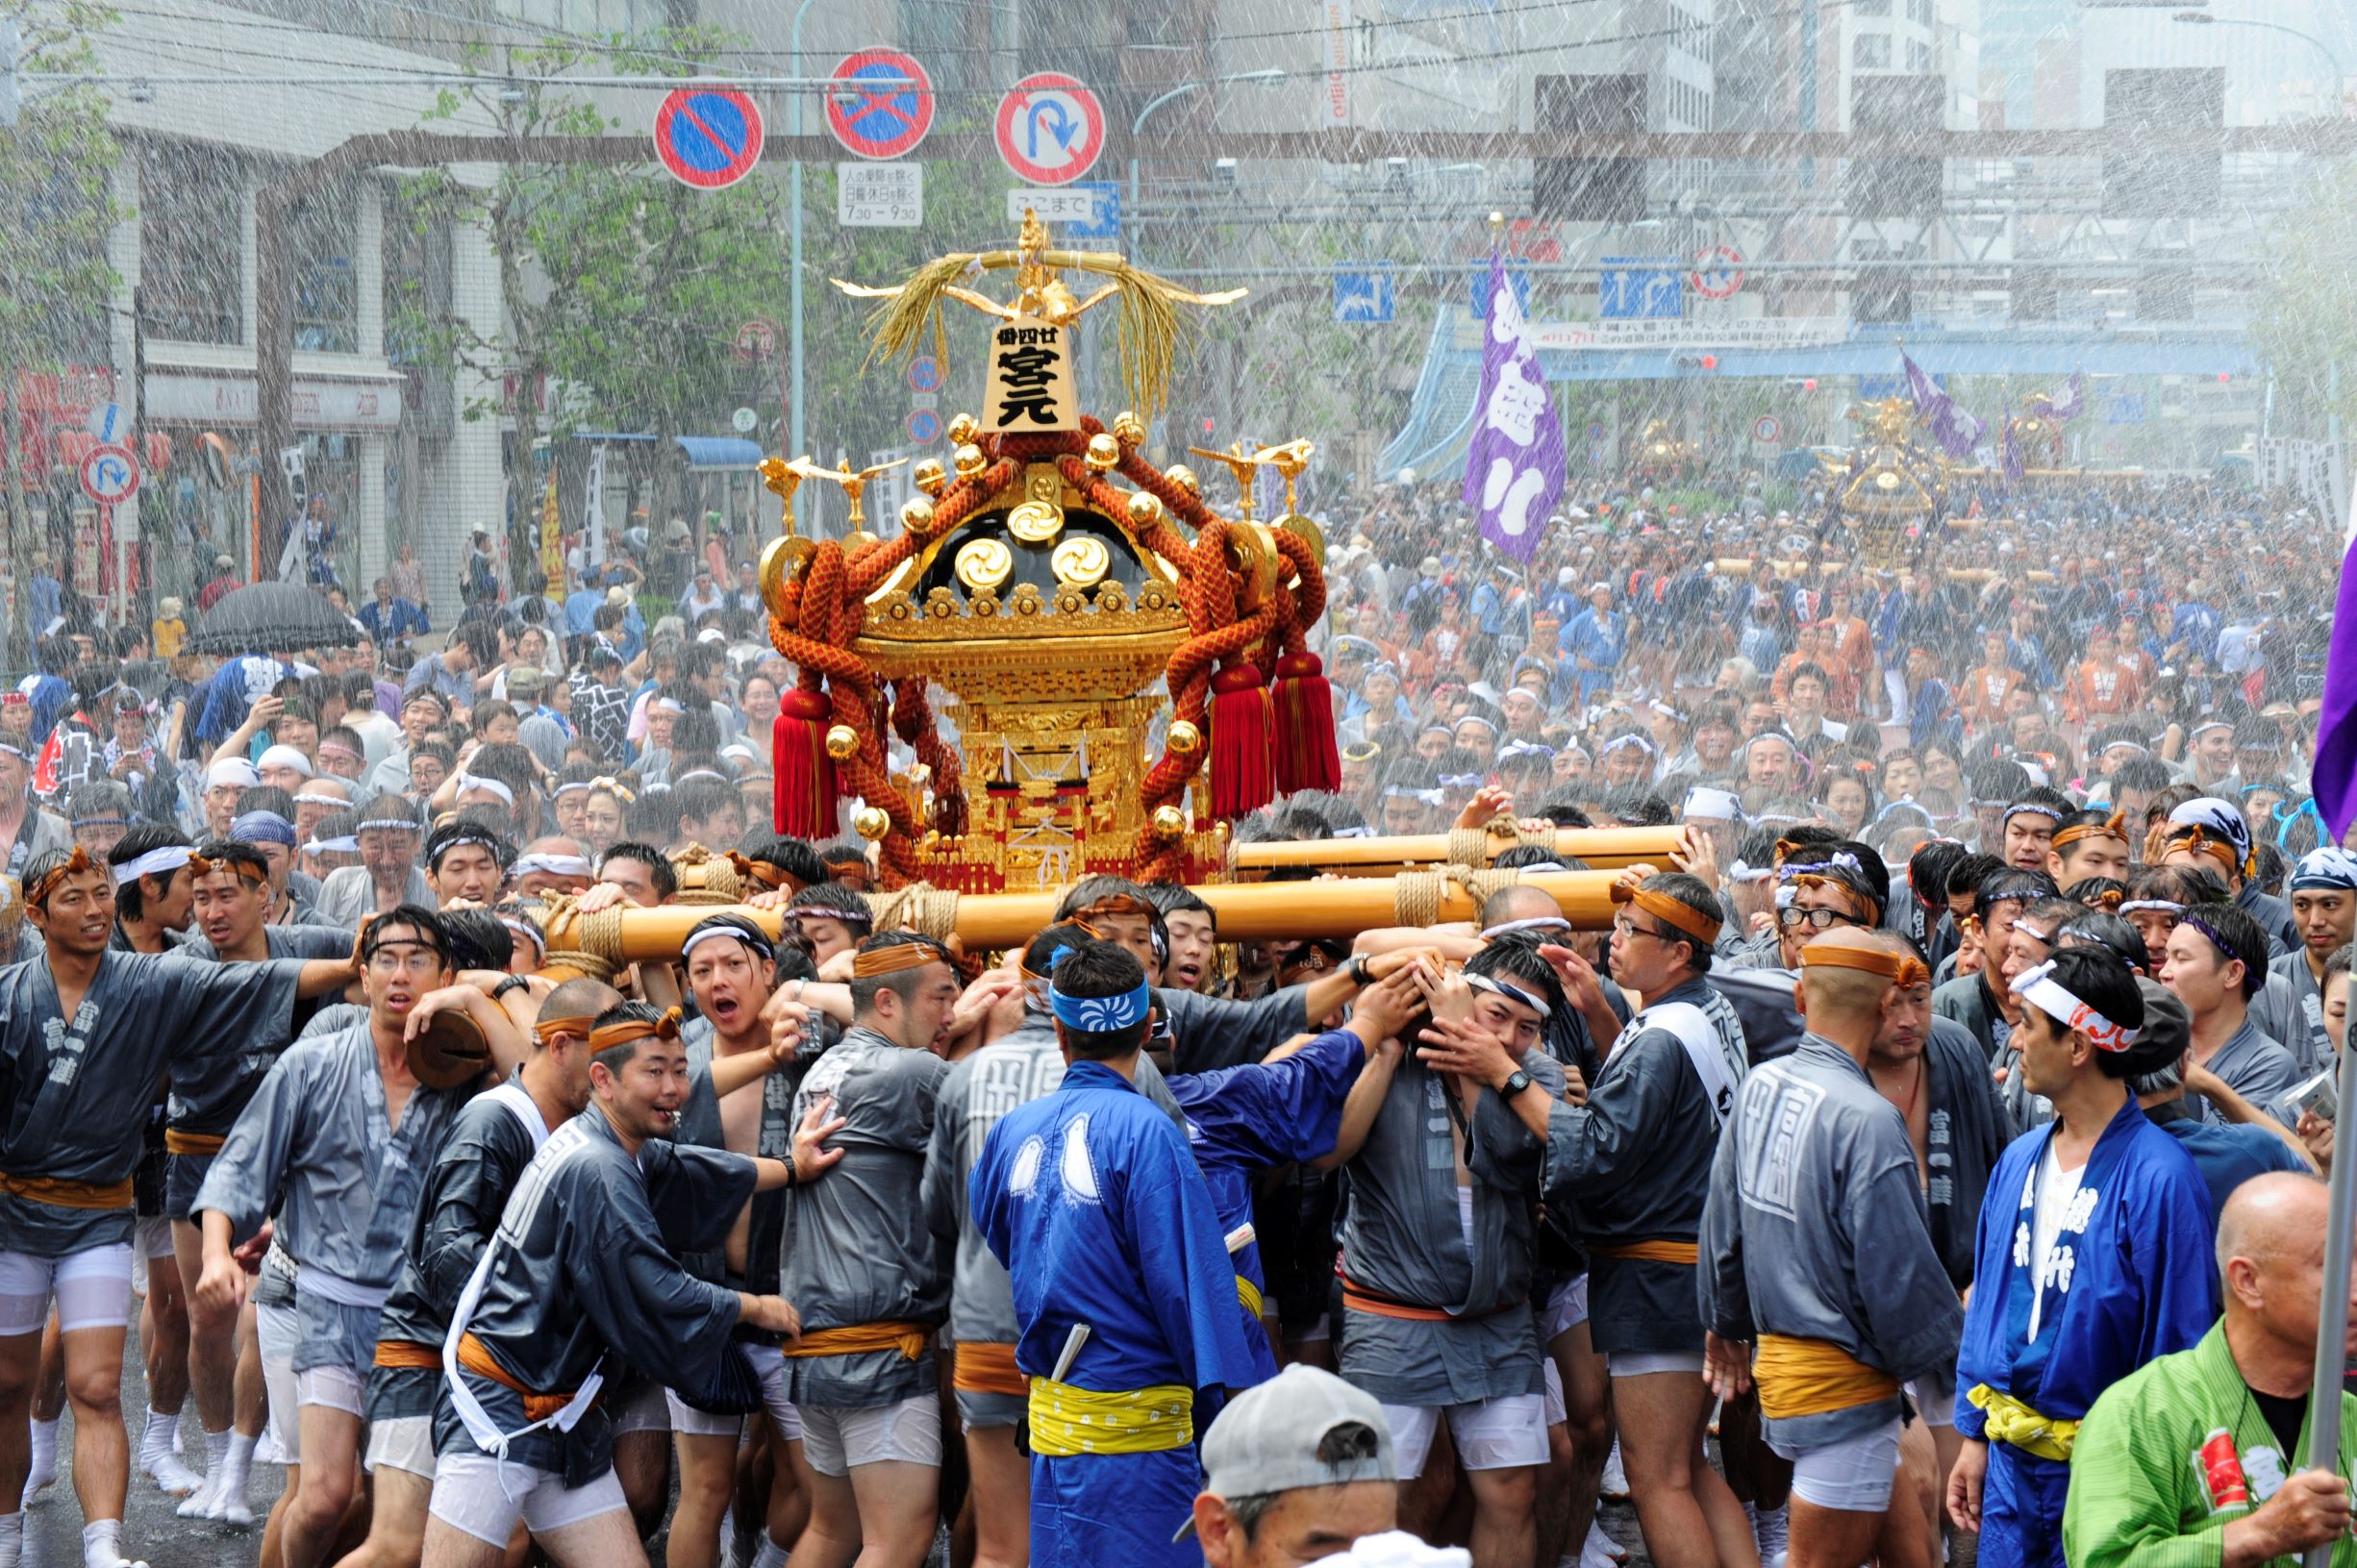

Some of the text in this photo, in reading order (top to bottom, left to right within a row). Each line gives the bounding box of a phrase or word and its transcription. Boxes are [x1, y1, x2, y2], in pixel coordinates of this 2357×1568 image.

[1016, 196, 1086, 213] ここまで
[997, 346, 1061, 427] 宮元
